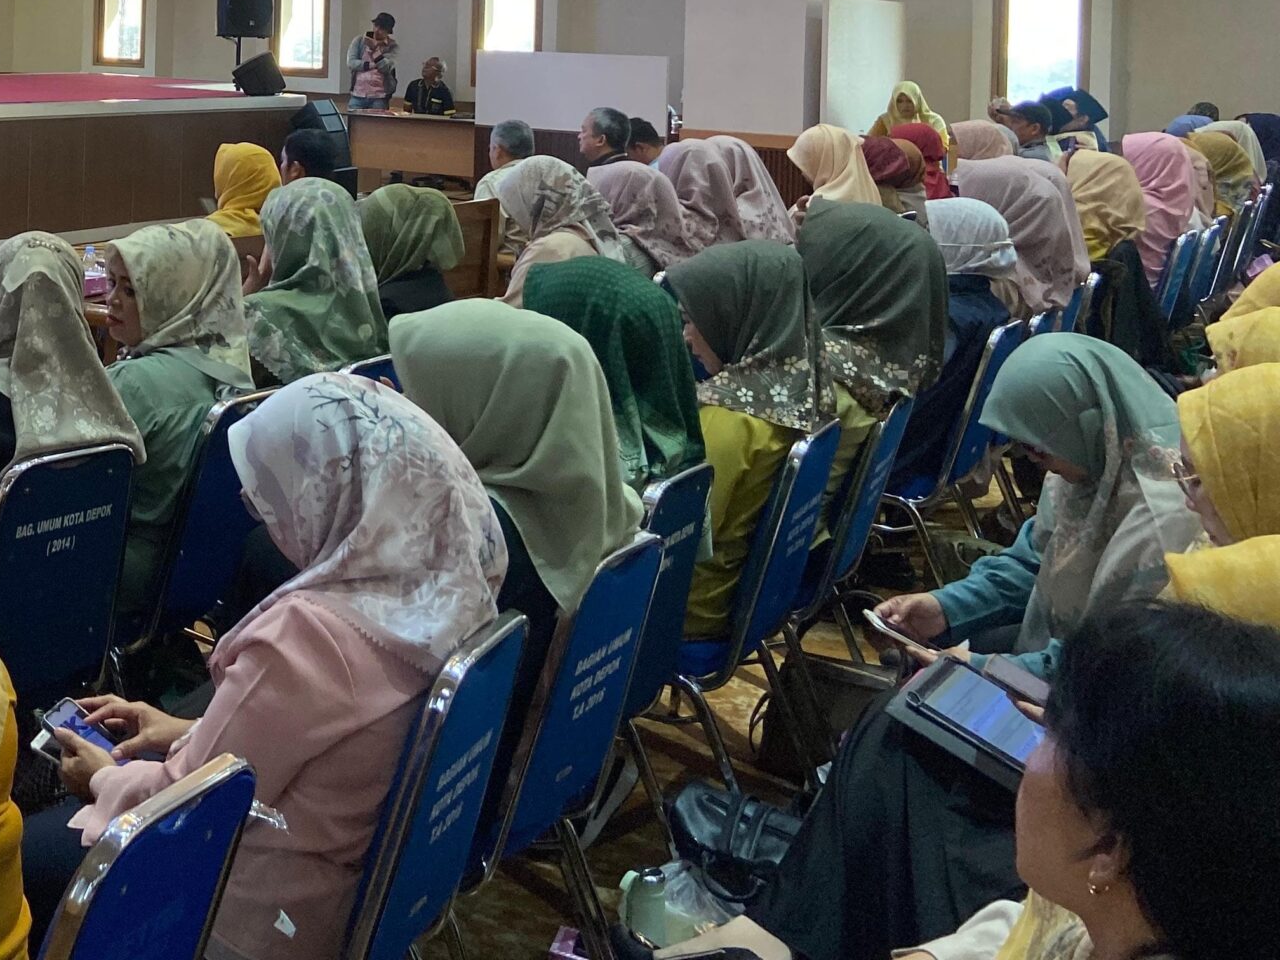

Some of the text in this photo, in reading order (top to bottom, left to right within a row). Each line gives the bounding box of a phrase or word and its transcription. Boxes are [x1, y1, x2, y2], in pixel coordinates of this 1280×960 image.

[15, 503, 113, 539] BAG. UMUM KOTA DEPOK
